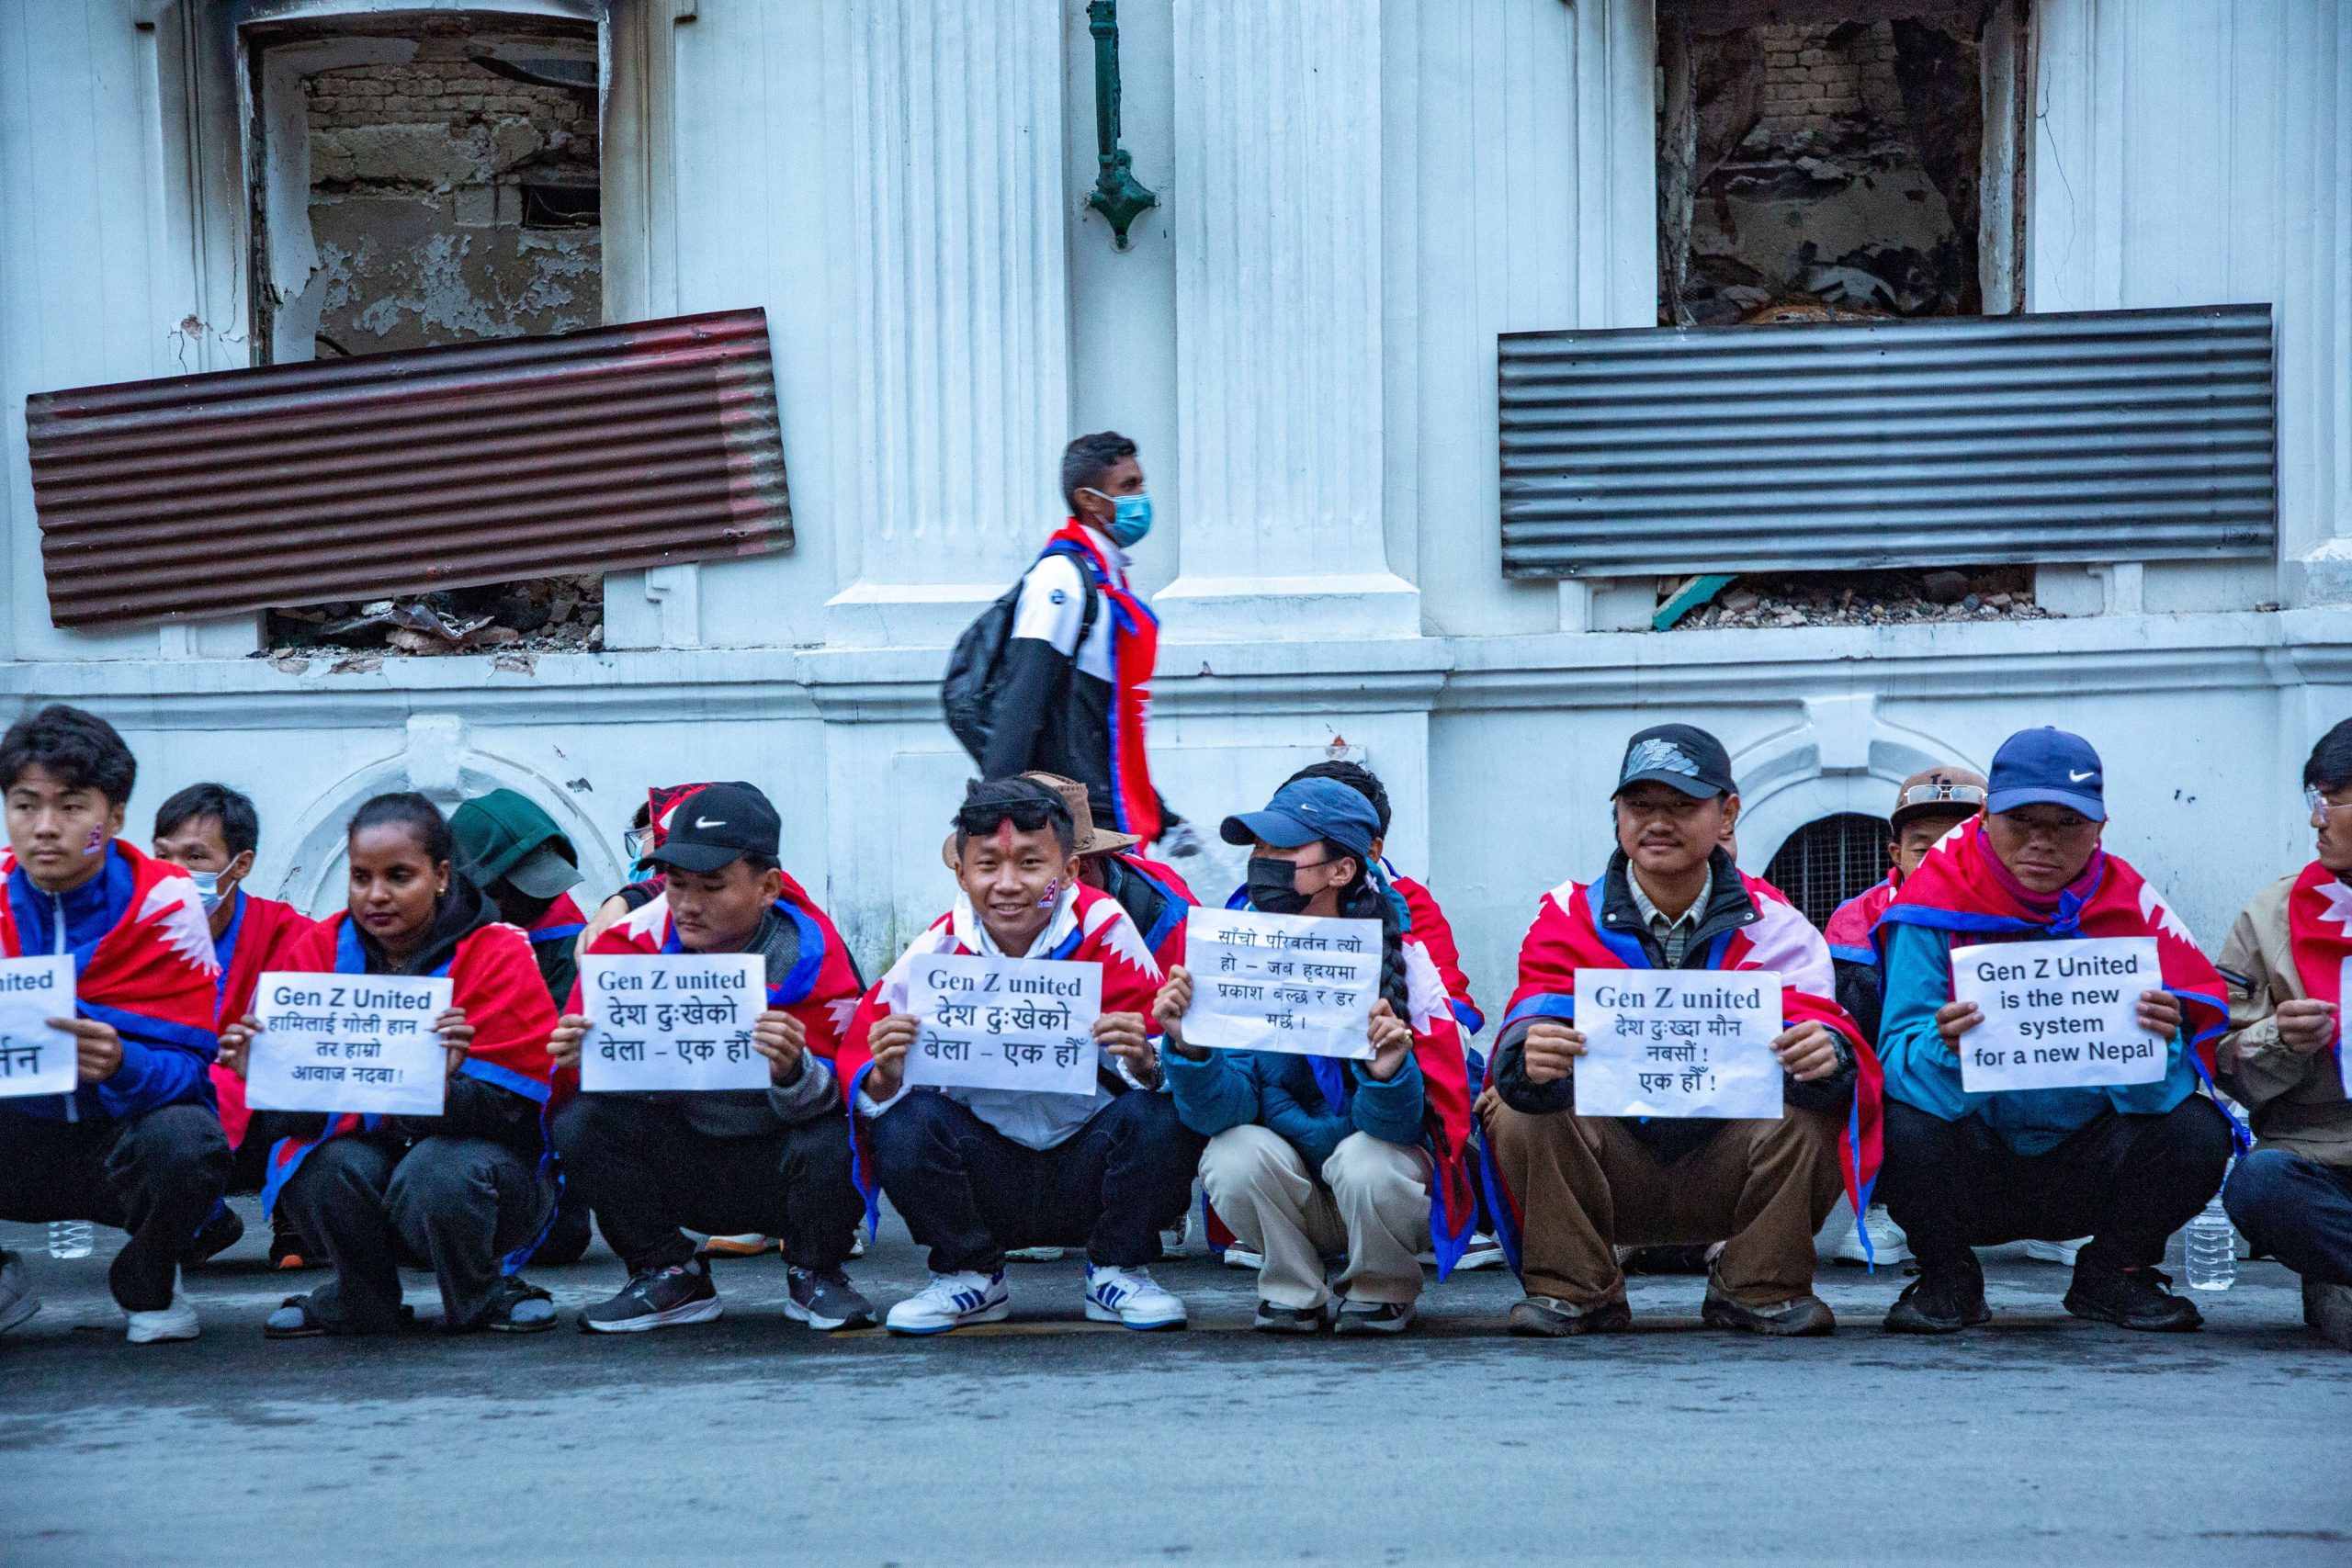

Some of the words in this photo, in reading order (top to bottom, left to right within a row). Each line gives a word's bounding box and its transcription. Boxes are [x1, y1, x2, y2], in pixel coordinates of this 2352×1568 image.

[1266, 931, 1329, 952] परिवर्तन
[1337, 935, 1363, 953] त्यो
[1221, 953, 1238, 972] हो
[1977, 962, 2026, 982] Gen
[2034, 959, 2050, 978] Z
[2057, 954, 2138, 977] United
[598, 971, 642, 990] Gen
[651, 971, 668, 989] Z
[676, 969, 746, 989] united
[928, 970, 974, 991] Gen
[983, 973, 1000, 992] Z
[1010, 976, 1080, 997] united
[274, 987, 321, 1006] Gen
[329, 988, 345, 1007] Z
[354, 989, 431, 1010] United
[1217, 984, 1264, 1000] प्रकाश
[1316, 990, 1326, 1004] र
[1333, 990, 1357, 1007] डर
[1595, 987, 1645, 1008] Gen
[1655, 987, 1673, 1008] Z
[1683, 987, 1760, 1009] united
[2001, 991, 2019, 1009] is
[2027, 988, 2064, 1007] the
[2072, 989, 2120, 1005] new
[267, 1011, 337, 1035] हामिलाई
[342, 1013, 381, 1032] गोली
[387, 1020, 418, 1035] हान
[607, 997, 648, 1028] देश
[936, 996, 978, 1028] देश
[1614, 1014, 1645, 1037] देश
[1707, 1014, 1742, 1036] मौन
[2019, 1017, 2104, 1040] system
[316, 1042, 339, 1056] तर
[675, 1040, 717, 1065] एक
[1002, 1043, 1046, 1066] एक
[1975, 1048, 2006, 1066] for
[2014, 1051, 2027, 1065] a
[2034, 1047, 2080, 1063] new
[2088, 1039, 2154, 1064] Nepal
[291, 1066, 346, 1081] आवाज
[1639, 1073, 1674, 1093] एक
